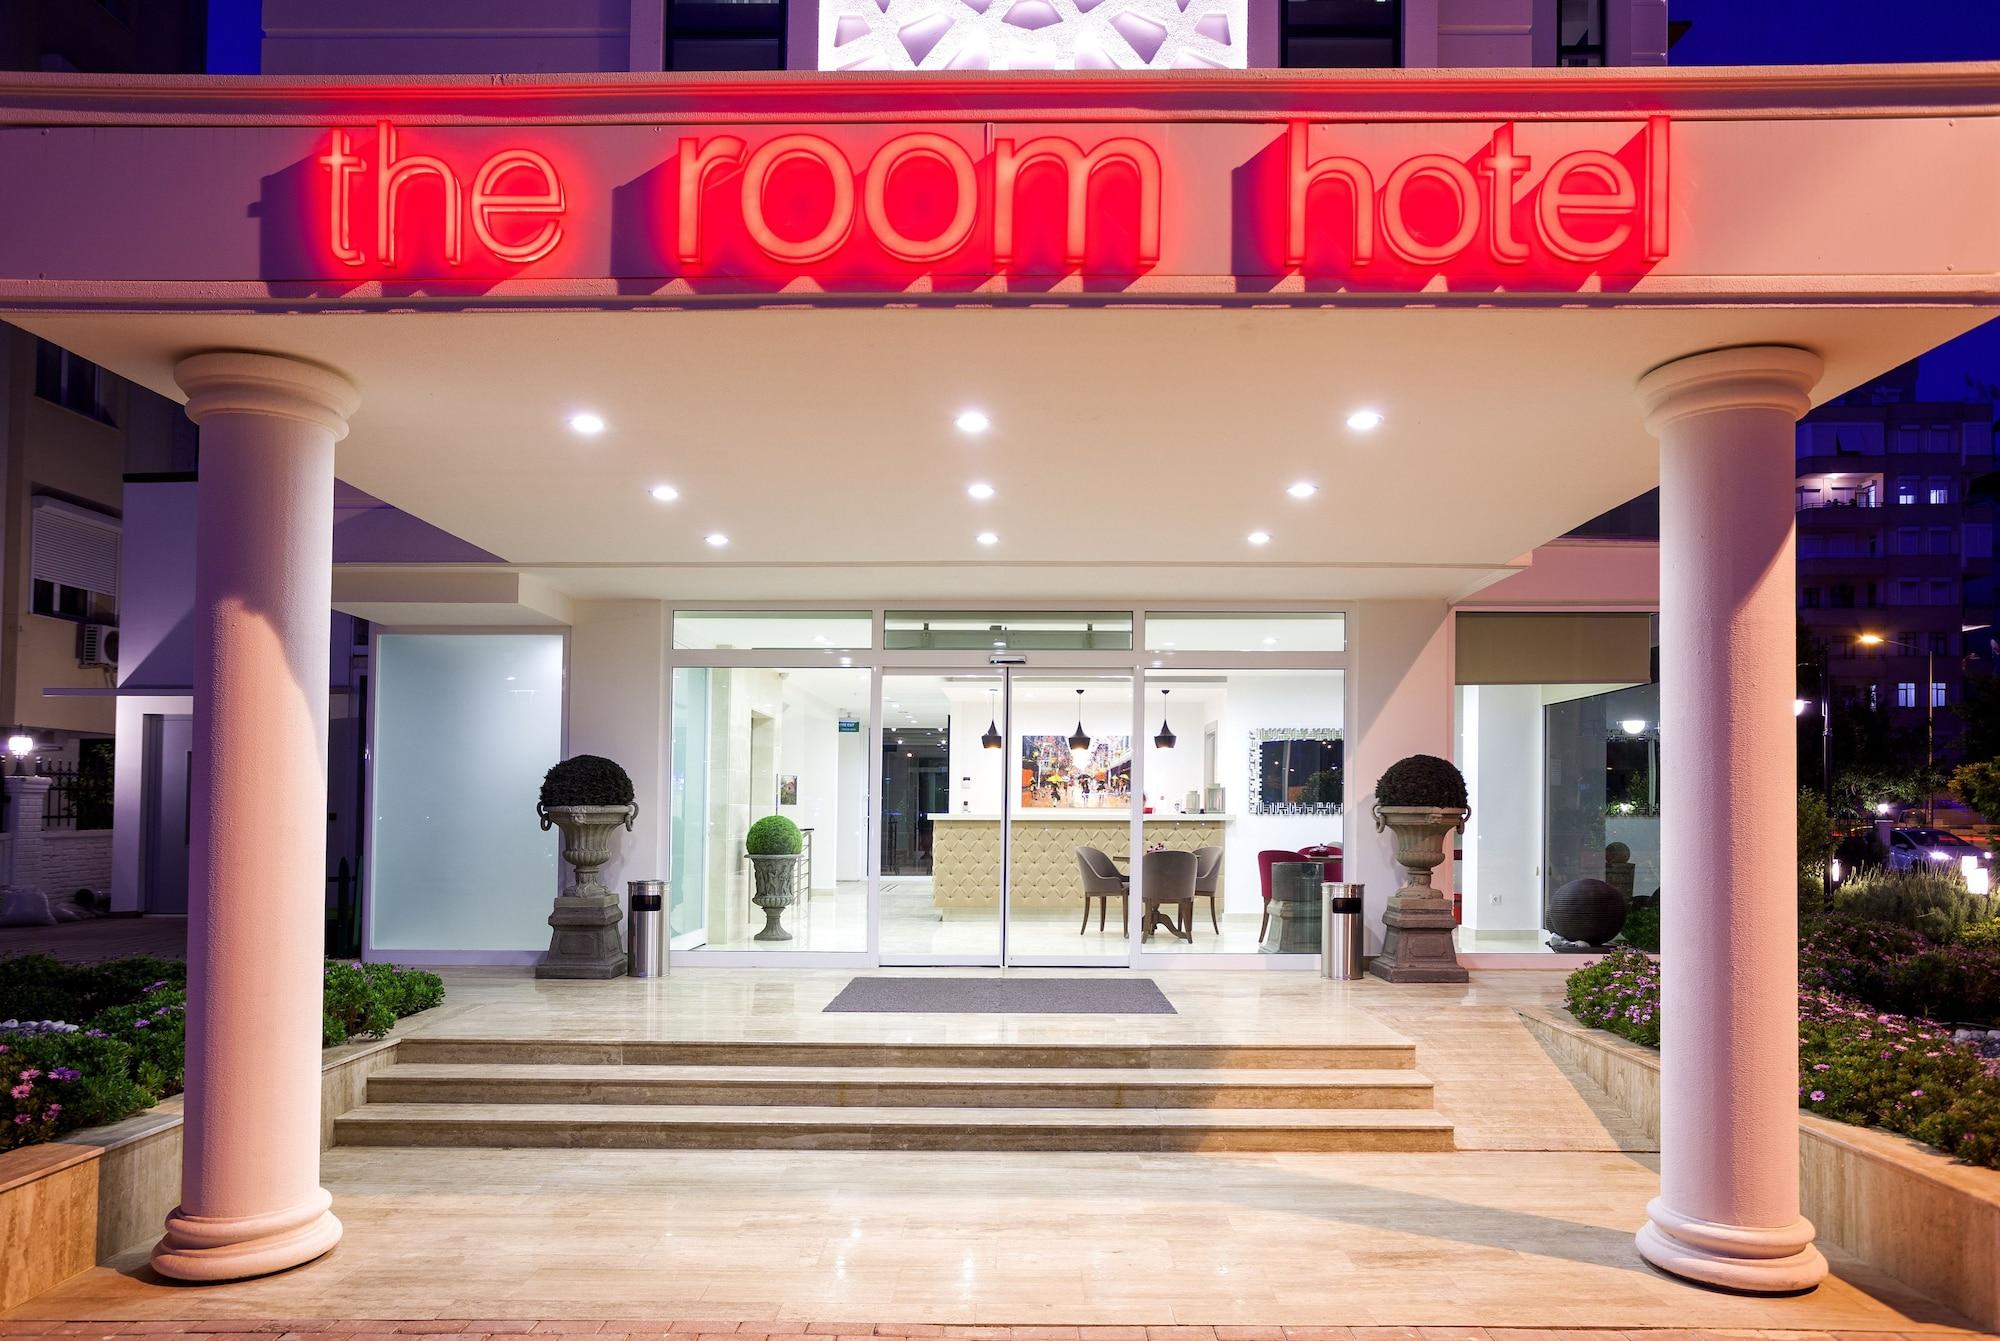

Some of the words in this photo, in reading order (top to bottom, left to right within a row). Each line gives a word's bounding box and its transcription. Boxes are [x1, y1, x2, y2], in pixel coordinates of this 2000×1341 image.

[320, 120, 566, 266] the
[676, 132, 1162, 266] room
[1286, 115, 1671, 267] hotel
